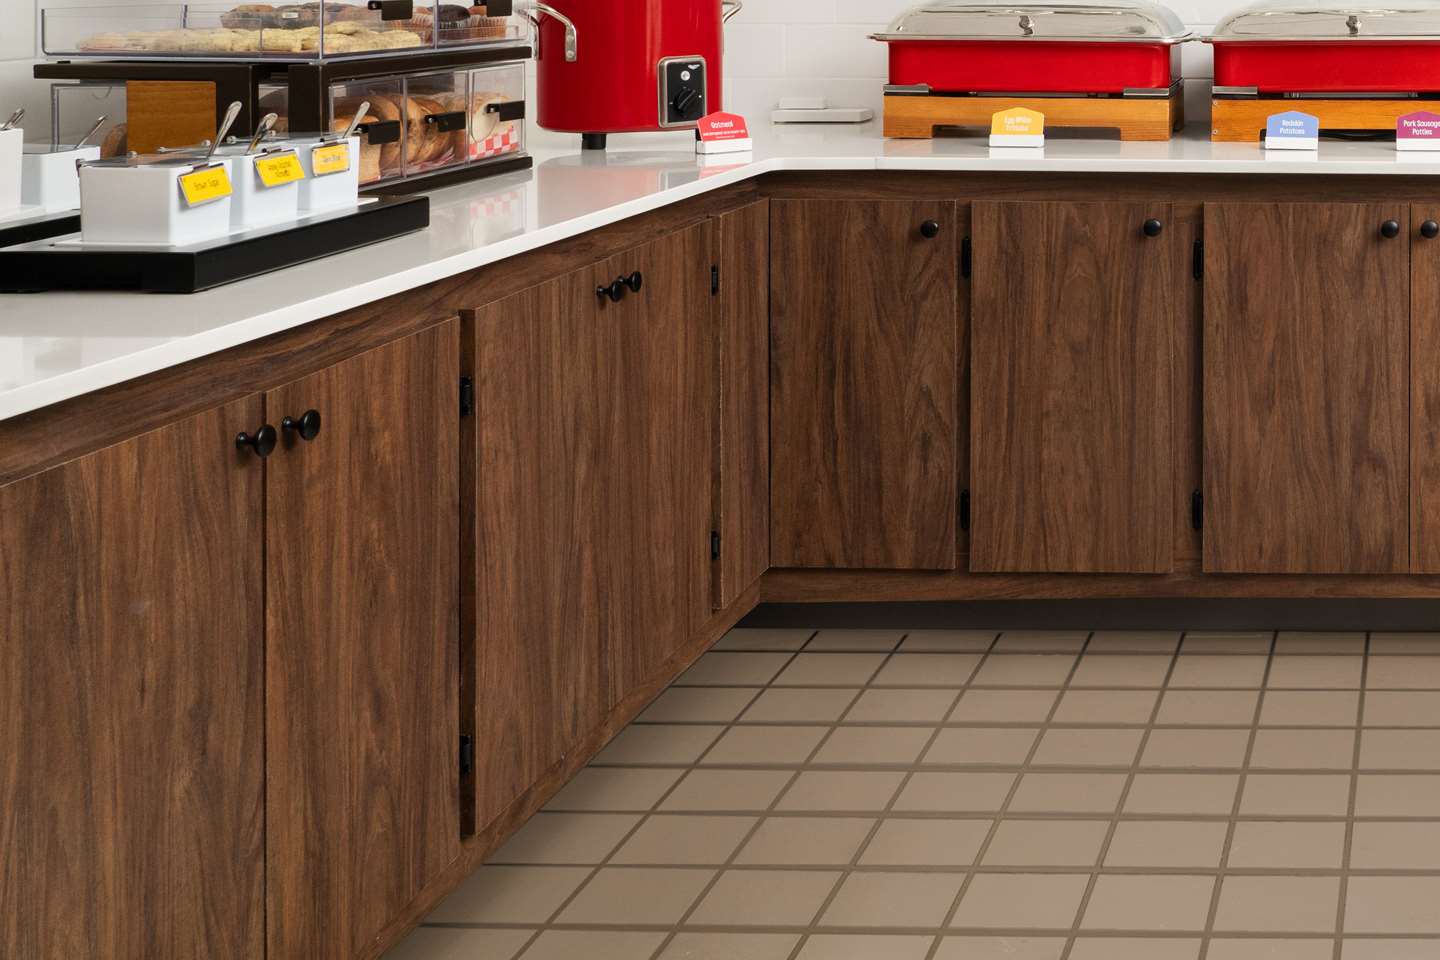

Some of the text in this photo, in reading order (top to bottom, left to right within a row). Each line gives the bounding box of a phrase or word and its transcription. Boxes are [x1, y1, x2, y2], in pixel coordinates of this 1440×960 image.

[710, 120, 734, 129] Oatmeal
[1403, 120, 1440, 129] Pork Sausage
[1412, 128, 1433, 136] Patties
